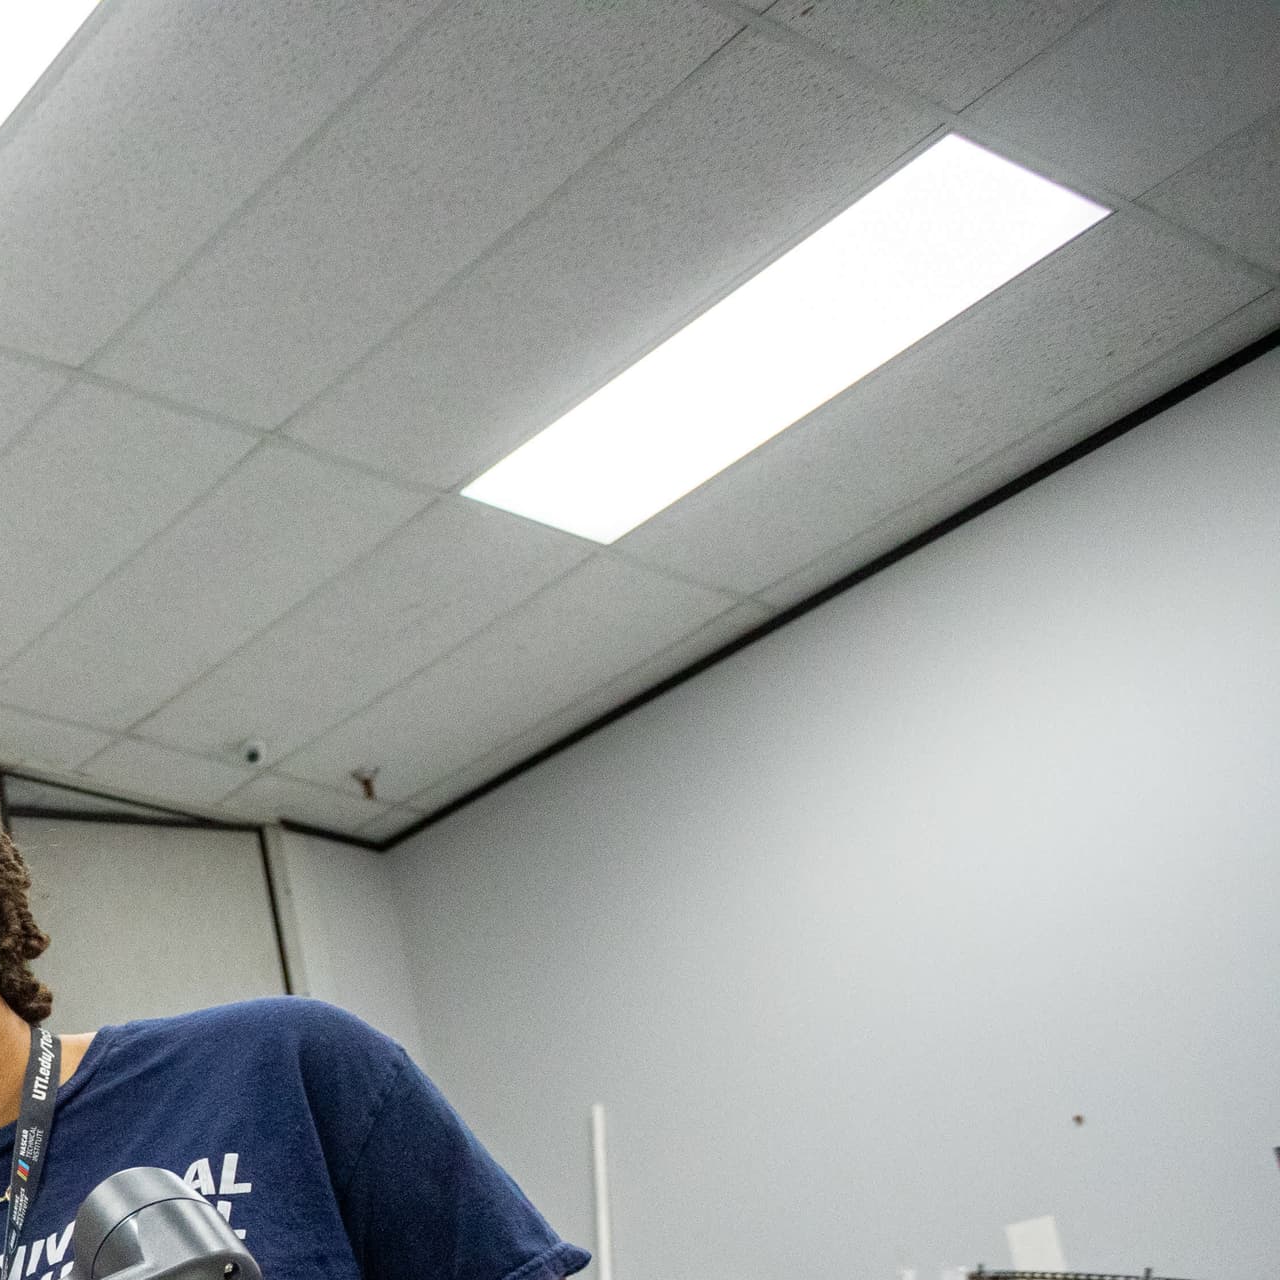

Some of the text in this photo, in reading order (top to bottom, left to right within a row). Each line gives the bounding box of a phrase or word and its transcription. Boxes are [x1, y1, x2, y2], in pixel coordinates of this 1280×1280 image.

[19, 1129, 29, 1157] NASCAR
[25, 1125, 38, 1159] TECHNICAL
[32, 1129, 44, 1162] INSTITUTE
